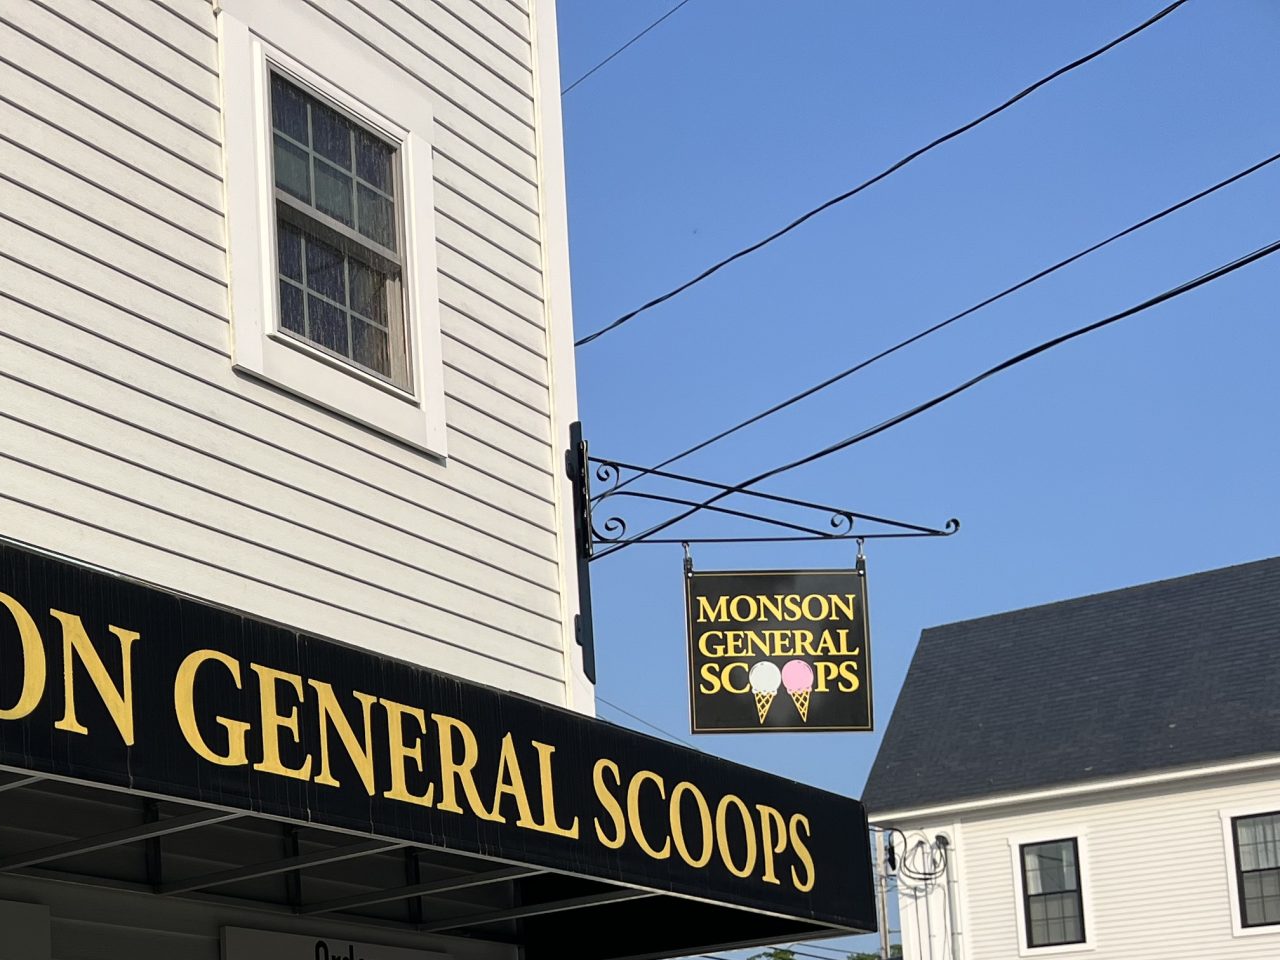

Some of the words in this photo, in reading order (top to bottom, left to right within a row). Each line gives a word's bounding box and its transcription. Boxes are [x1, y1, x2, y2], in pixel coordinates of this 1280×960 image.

[696, 594, 856, 622] MONSON
[698, 629, 860, 658] GENERAL
[174, 648, 580, 840] GENERAL
[592, 757, 816, 893] SCOOPS
